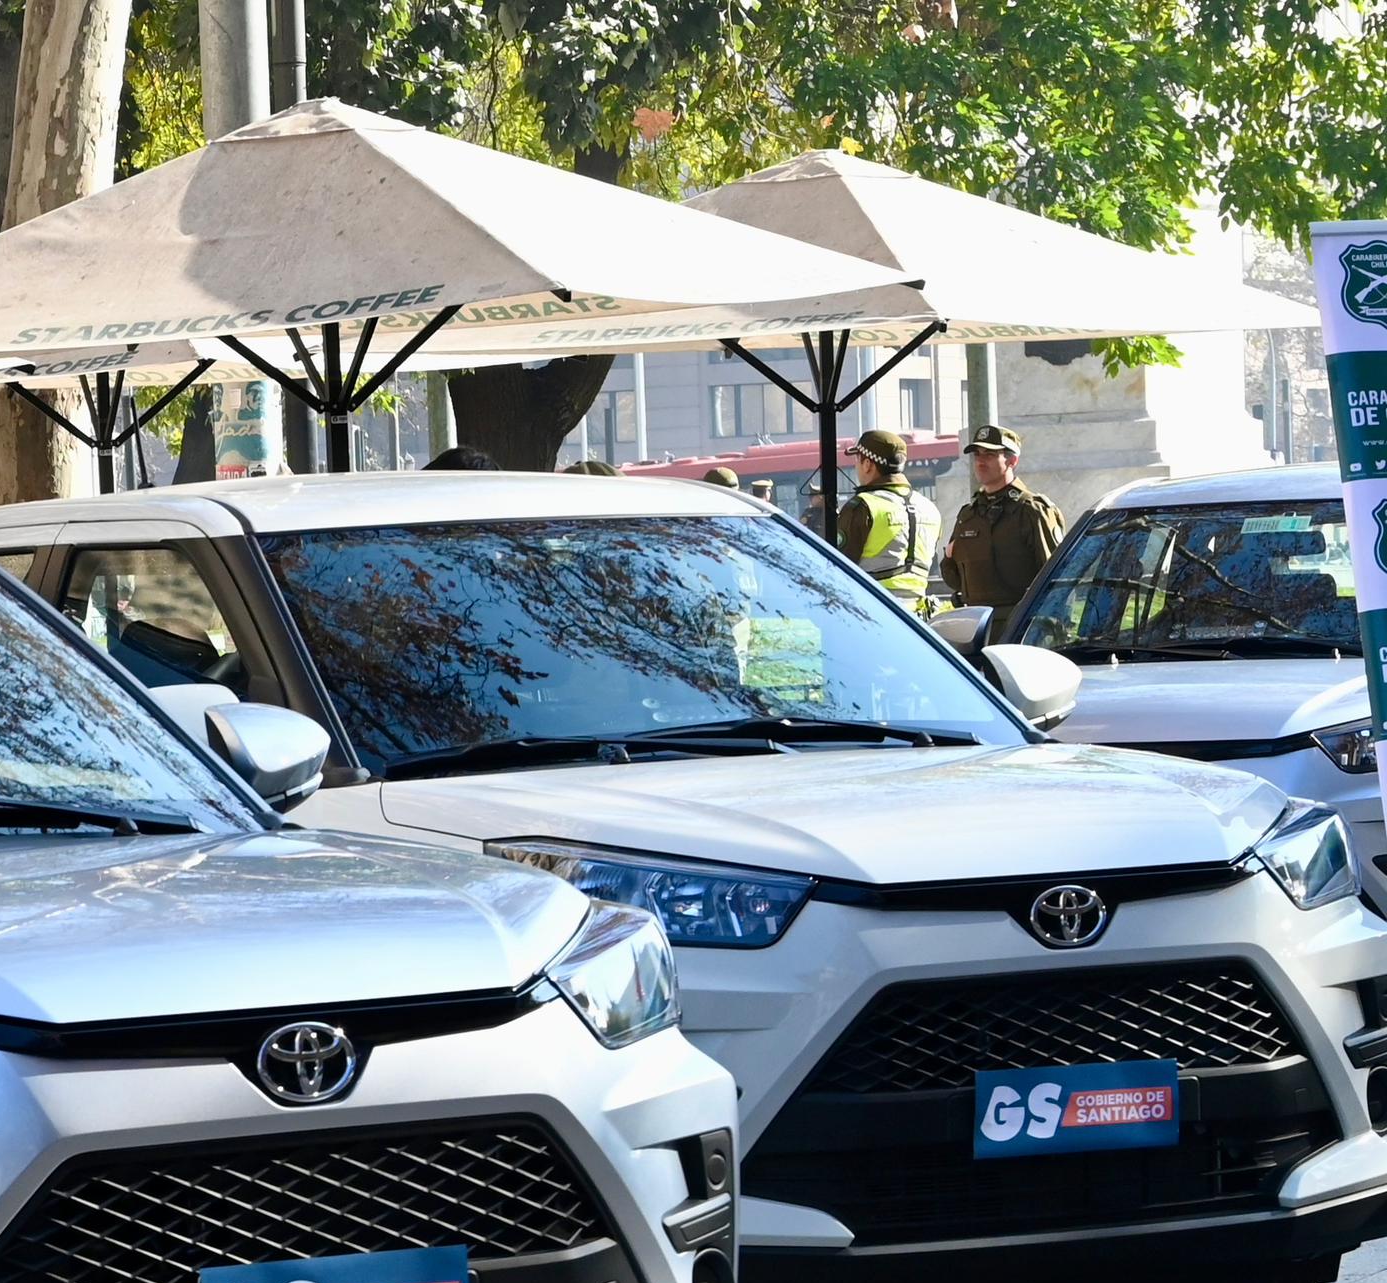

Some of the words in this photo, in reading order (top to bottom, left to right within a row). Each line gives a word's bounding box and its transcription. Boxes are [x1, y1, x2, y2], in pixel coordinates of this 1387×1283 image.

[9, 308, 275, 345] STARBUCKS
[284, 283, 446, 323] COFFEE
[1350, 406, 1380, 427] DE
[1076, 1092, 1143, 1107] GOBIERNO
[1146, 1091, 1165, 1103] DE
[980, 1082, 1063, 1142] GS
[1076, 1104, 1166, 1124] SANTIAGO
